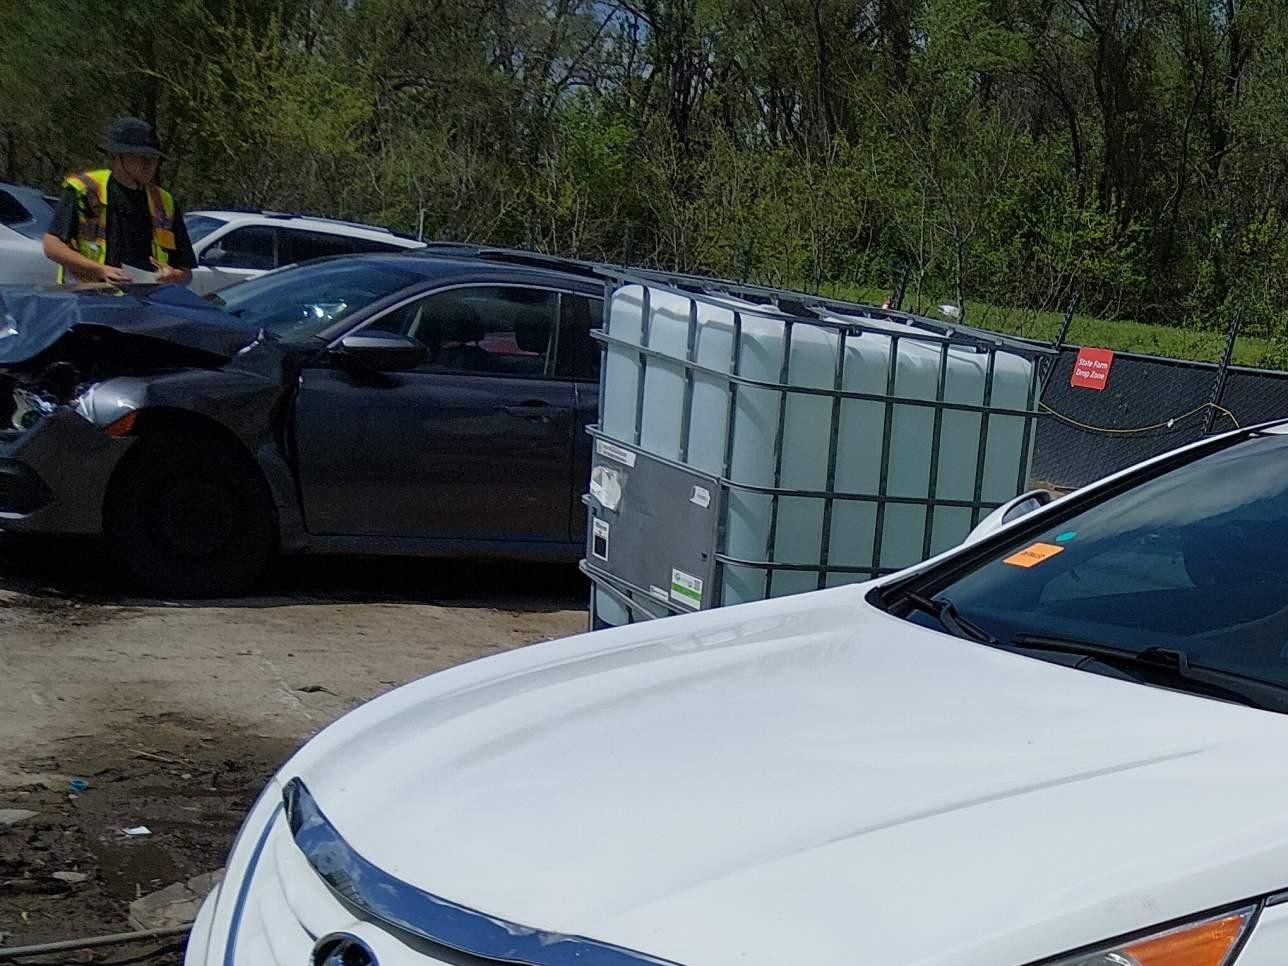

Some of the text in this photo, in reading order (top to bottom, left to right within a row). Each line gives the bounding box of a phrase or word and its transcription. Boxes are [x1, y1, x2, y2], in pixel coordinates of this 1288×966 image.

[1078, 358, 1108, 369] State Farm
[1075, 368, 1105, 380] Drop Zone
